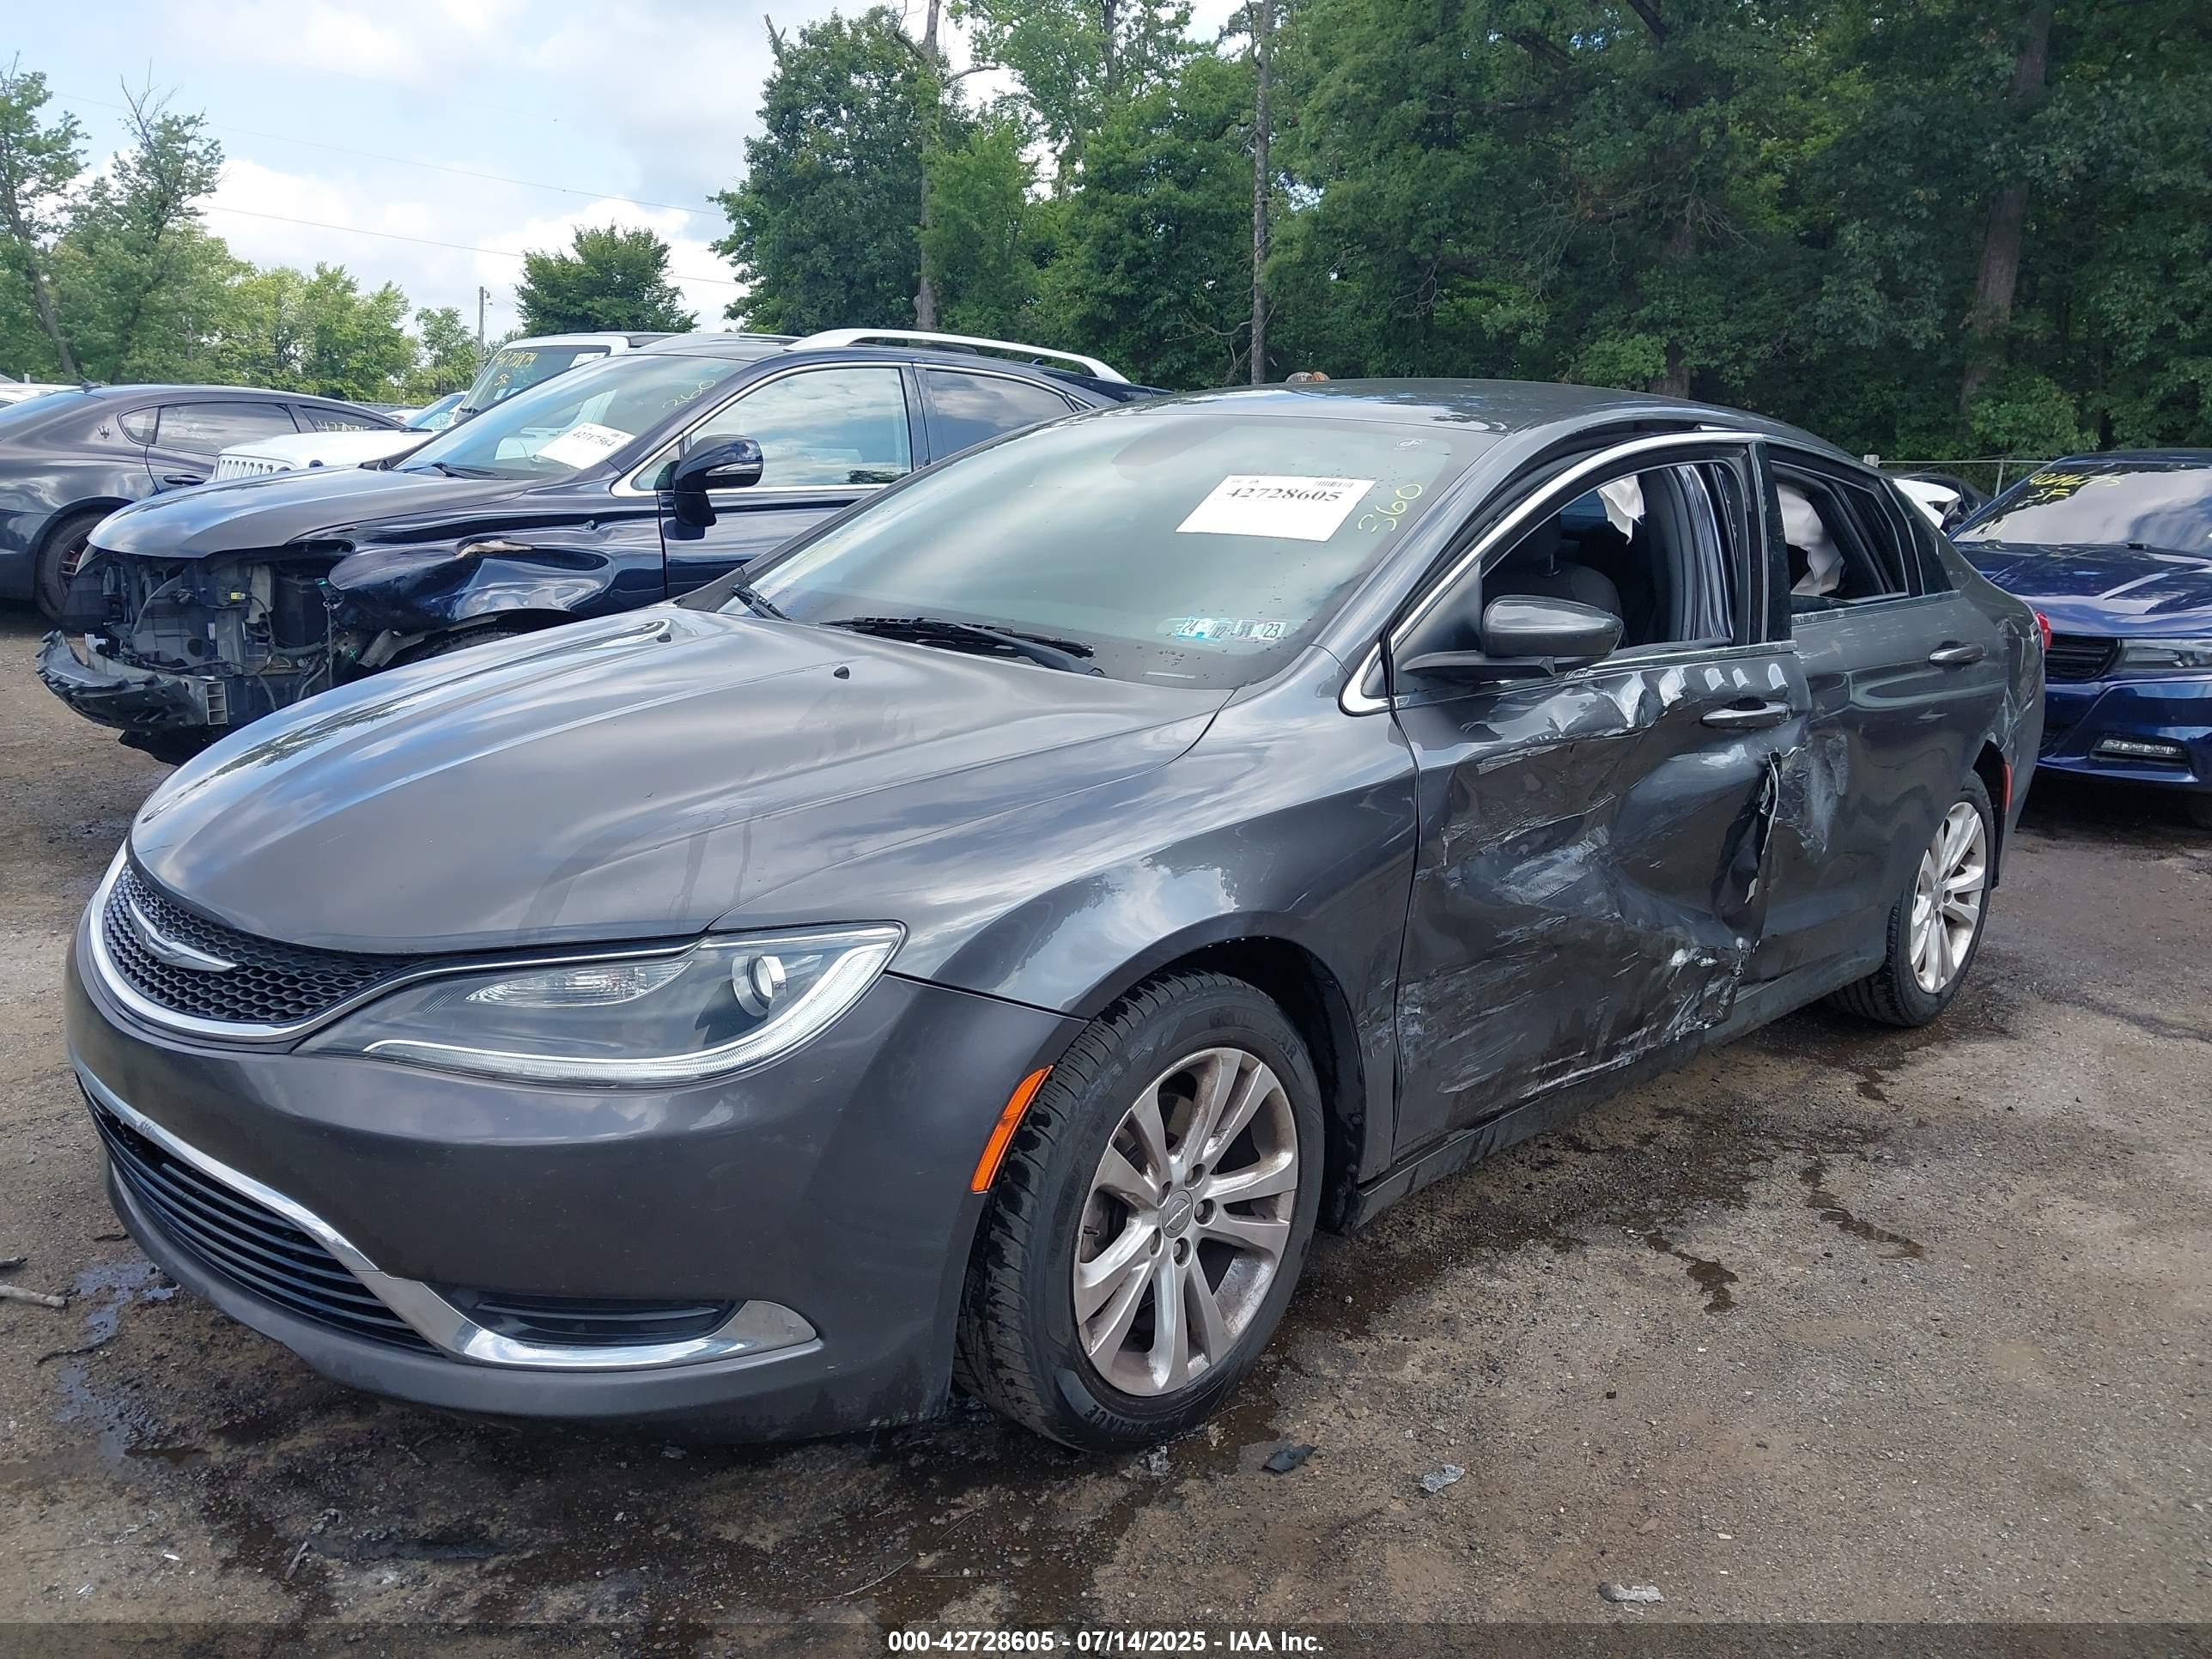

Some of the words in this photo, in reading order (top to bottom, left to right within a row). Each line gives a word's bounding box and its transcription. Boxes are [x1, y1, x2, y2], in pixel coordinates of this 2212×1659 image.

[1225, 488, 1345, 502] 42728605
[2027, 488, 2070, 501] SF
[1358, 483, 1423, 534] 360
[1263, 623, 1281, 638] 23
